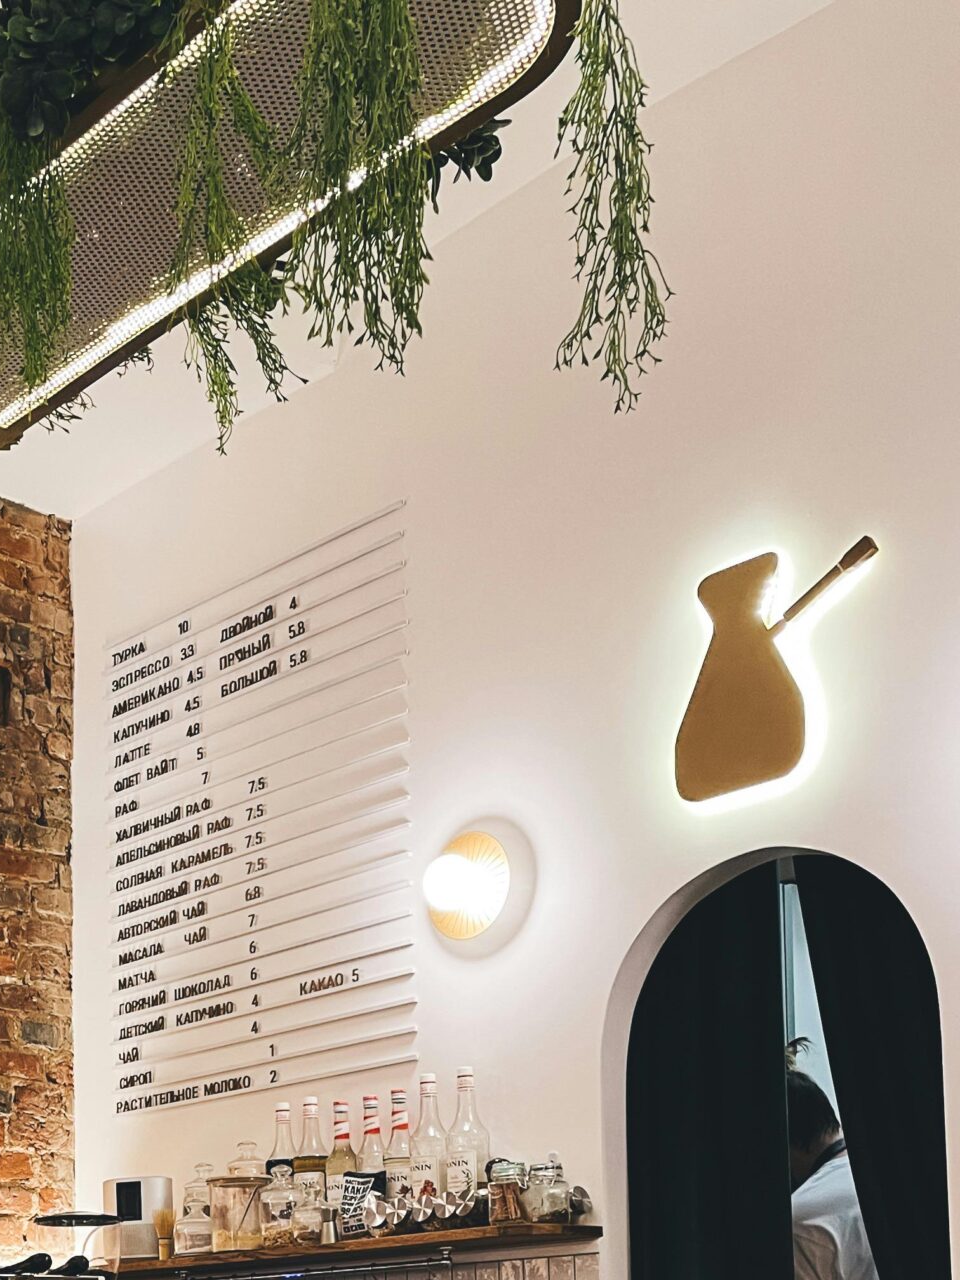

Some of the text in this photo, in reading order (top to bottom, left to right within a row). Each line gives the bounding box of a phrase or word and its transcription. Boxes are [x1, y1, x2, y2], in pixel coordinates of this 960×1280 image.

[112, 620, 188, 667] ТУРКА 10
[112, 656, 170, 692] ЭСПРЕССО
[220, 605, 273, 643] ДВОЙНОЙ
[289, 596, 297, 610] 4
[112, 677, 179, 718] АМЕРИКАНО
[186, 667, 203, 683] 4.5
[288, 621, 305, 639] 5.8
[113, 650, 307, 744] КАПУЧИНО 4.5 БОЛЬШОЙ 5.8
[114, 747, 203, 792] ФЛЕТ ВАЙТ 5
[115, 743, 150, 768] ЛАТТЕ
[115, 772, 208, 818] РАФ 7
[115, 777, 265, 843] ХАЛВИЧНЫЙ РАФ 7.5
[115, 804, 264, 867] АПЕЛЬСИНОВЫЙ РАФ 7.5
[116, 832, 262, 892] СОЛЕНАЯ КАРАМЕЛЬ 7.5
[118, 858, 263, 917] ЛАВАНДОВЫЙ РАФ 7.5
[118, 910, 176, 942] АВТОРСКИЙ
[183, 901, 205, 920] ЧАЙ
[119, 914, 255, 966] МАСАЛА ЧАЙ 7
[118, 941, 256, 990] МАТЧА 6
[119, 968, 257, 1015] ГОРЯЧИЙ ШОКОЛАД 6
[119, 969, 359, 1040] ДЕТСКИЙ КАПУЧИНО 4 КАКАО 5
[119, 1022, 258, 1064] ЧАЙ 4
[120, 1044, 274, 1089] СИРОП 1
[117, 1070, 277, 1113] РАСТИТЕЛЬНОЕ МОЛОКО 2
